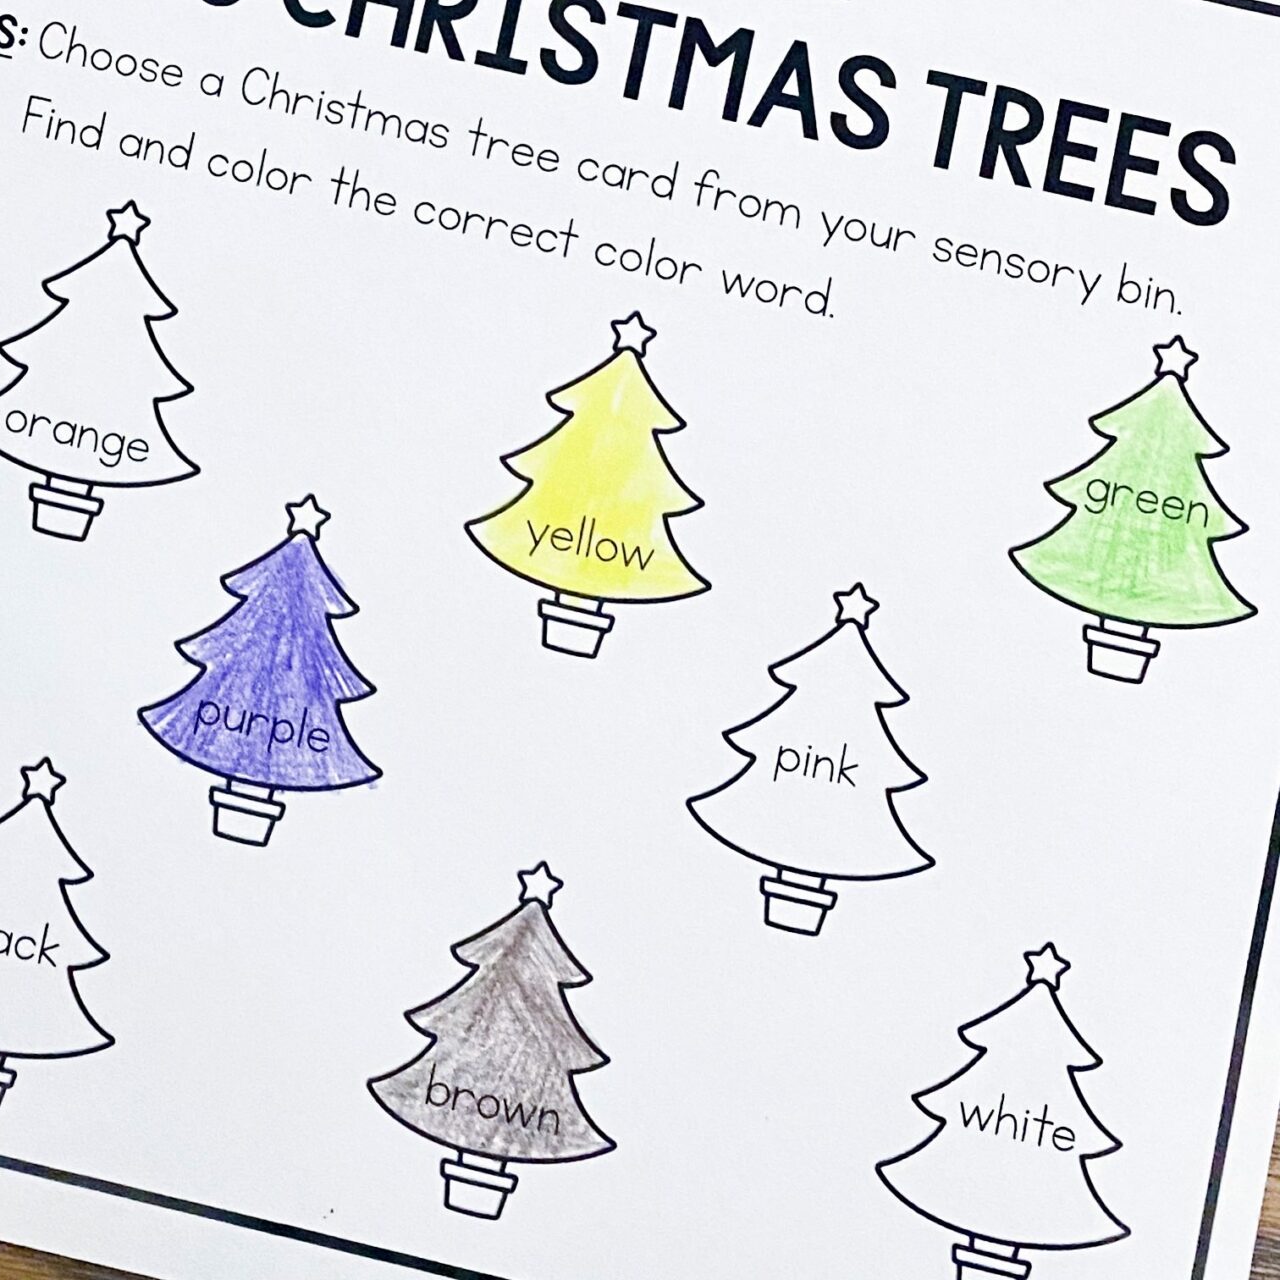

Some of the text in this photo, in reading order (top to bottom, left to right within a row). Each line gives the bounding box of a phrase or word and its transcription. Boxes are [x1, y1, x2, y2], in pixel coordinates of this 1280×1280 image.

[38, 20, 184, 88] Choose
[199, 72, 225, 98] a
[241, 66, 450, 149] Christmas
[467, 116, 560, 173] tree
[577, 157, 680, 201] card
[693, 168, 801, 230] from
[820, 210, 917, 253] your
[932, 236, 1103, 306] sensory
[1116, 261, 1182, 316] bin.
[925, 68, 1237, 227] TREES
[21, 94, 835, 319] Find and color the correct color word.
[4, 409, 150, 469] orange
[1083, 478, 1209, 529] green
[526, 514, 655, 572] yellow
[192, 699, 331, 759] purple
[772, 742, 860, 788] pink
[424, 1061, 561, 1136] brown
[959, 1092, 1076, 1153] white
